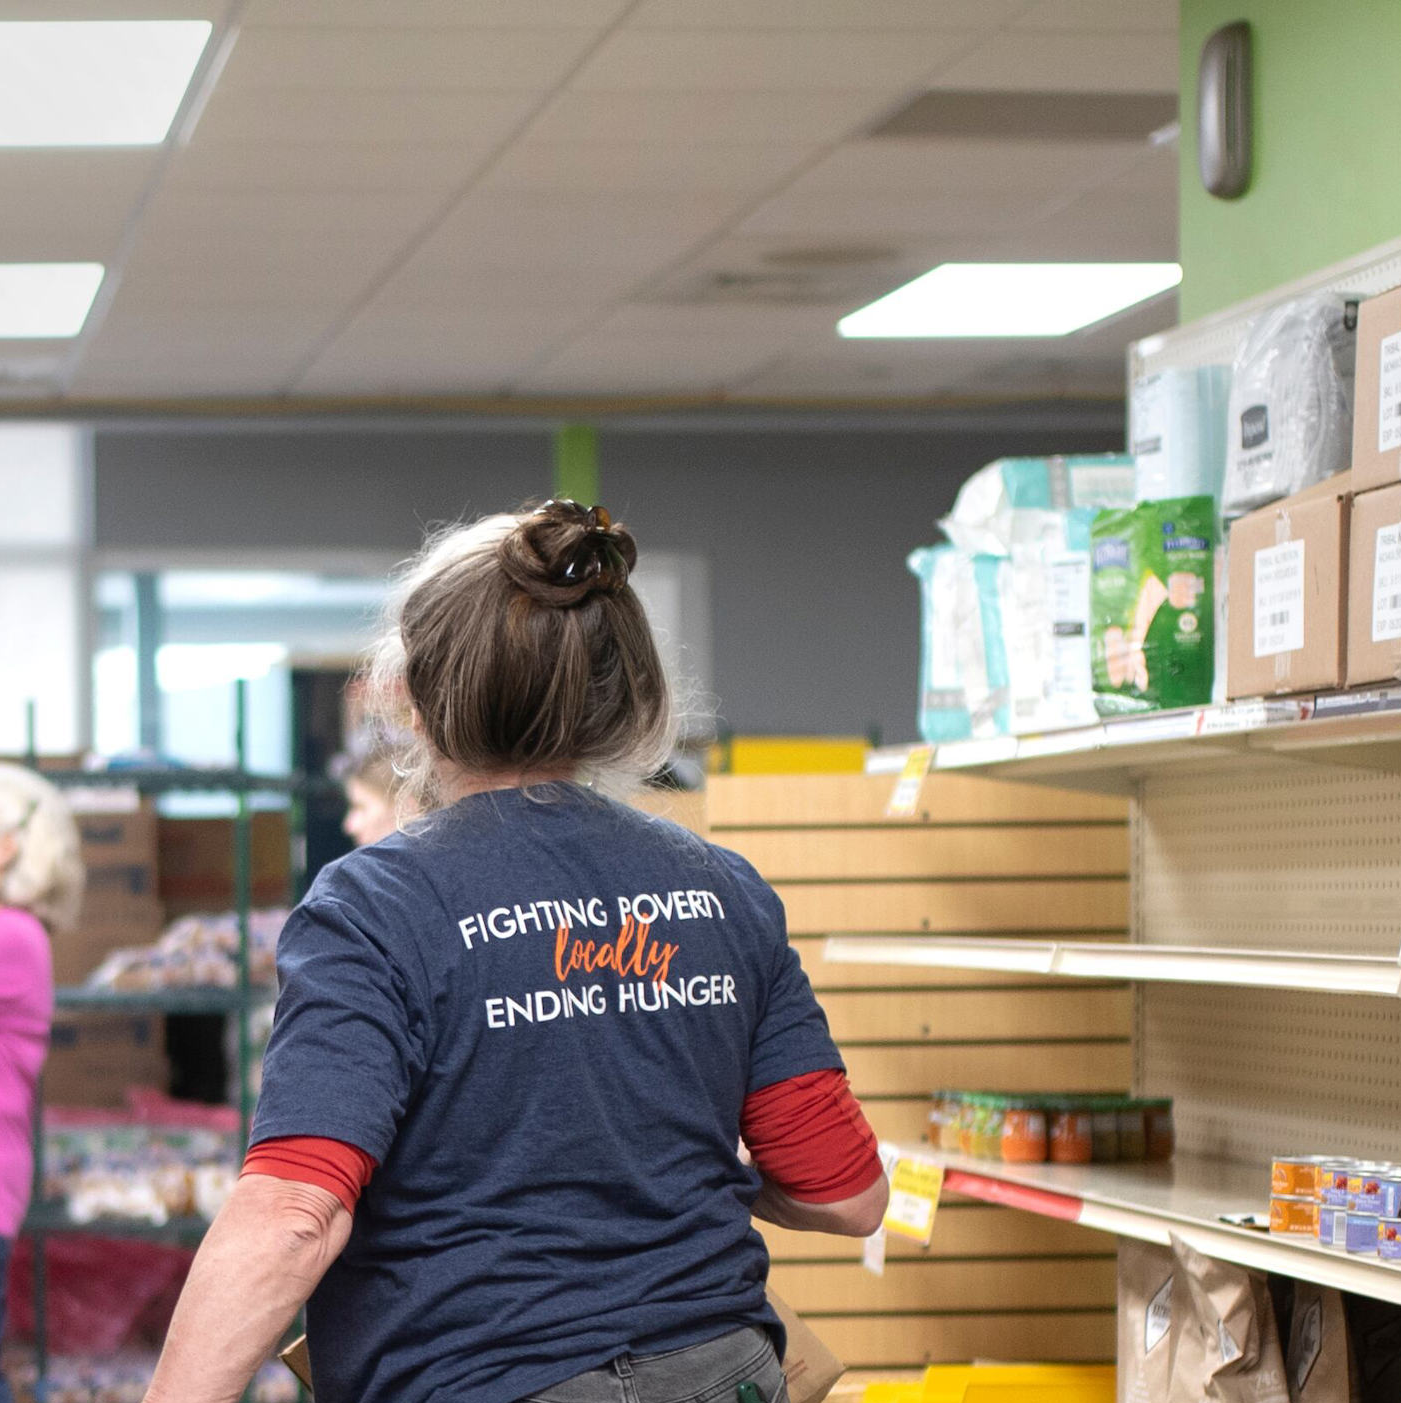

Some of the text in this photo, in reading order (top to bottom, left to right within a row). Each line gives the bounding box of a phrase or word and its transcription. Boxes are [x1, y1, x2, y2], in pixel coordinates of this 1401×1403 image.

[458, 898, 608, 950] FIGHTING
[554, 913, 679, 992] locally
[486, 974, 738, 1029] ENDING HUNGER
